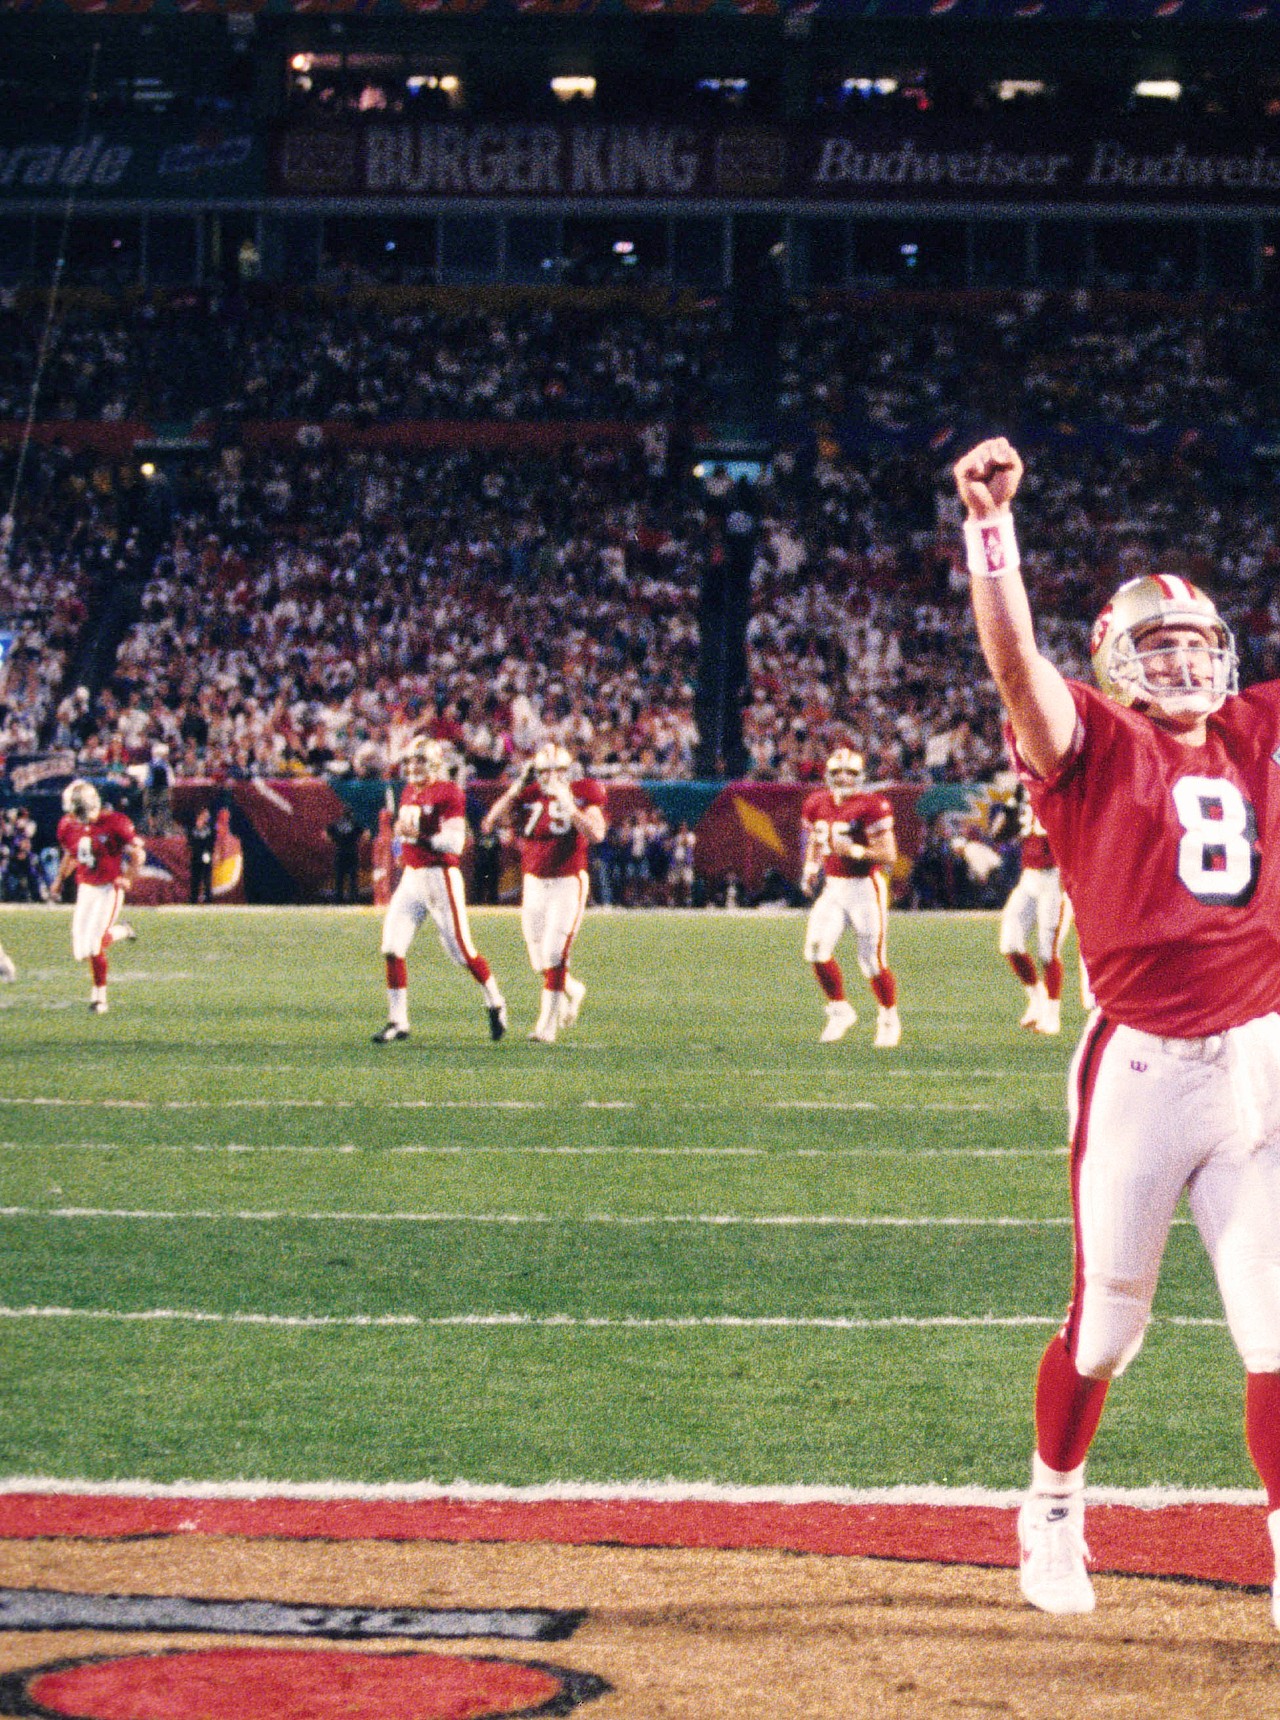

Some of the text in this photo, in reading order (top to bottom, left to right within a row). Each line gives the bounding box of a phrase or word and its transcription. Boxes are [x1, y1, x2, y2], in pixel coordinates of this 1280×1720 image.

[365, 125, 561, 190] BURGER
[570, 125, 698, 190] KING
[813, 136, 1070, 185] Budweiser
[1172, 775, 1257, 901] 8
